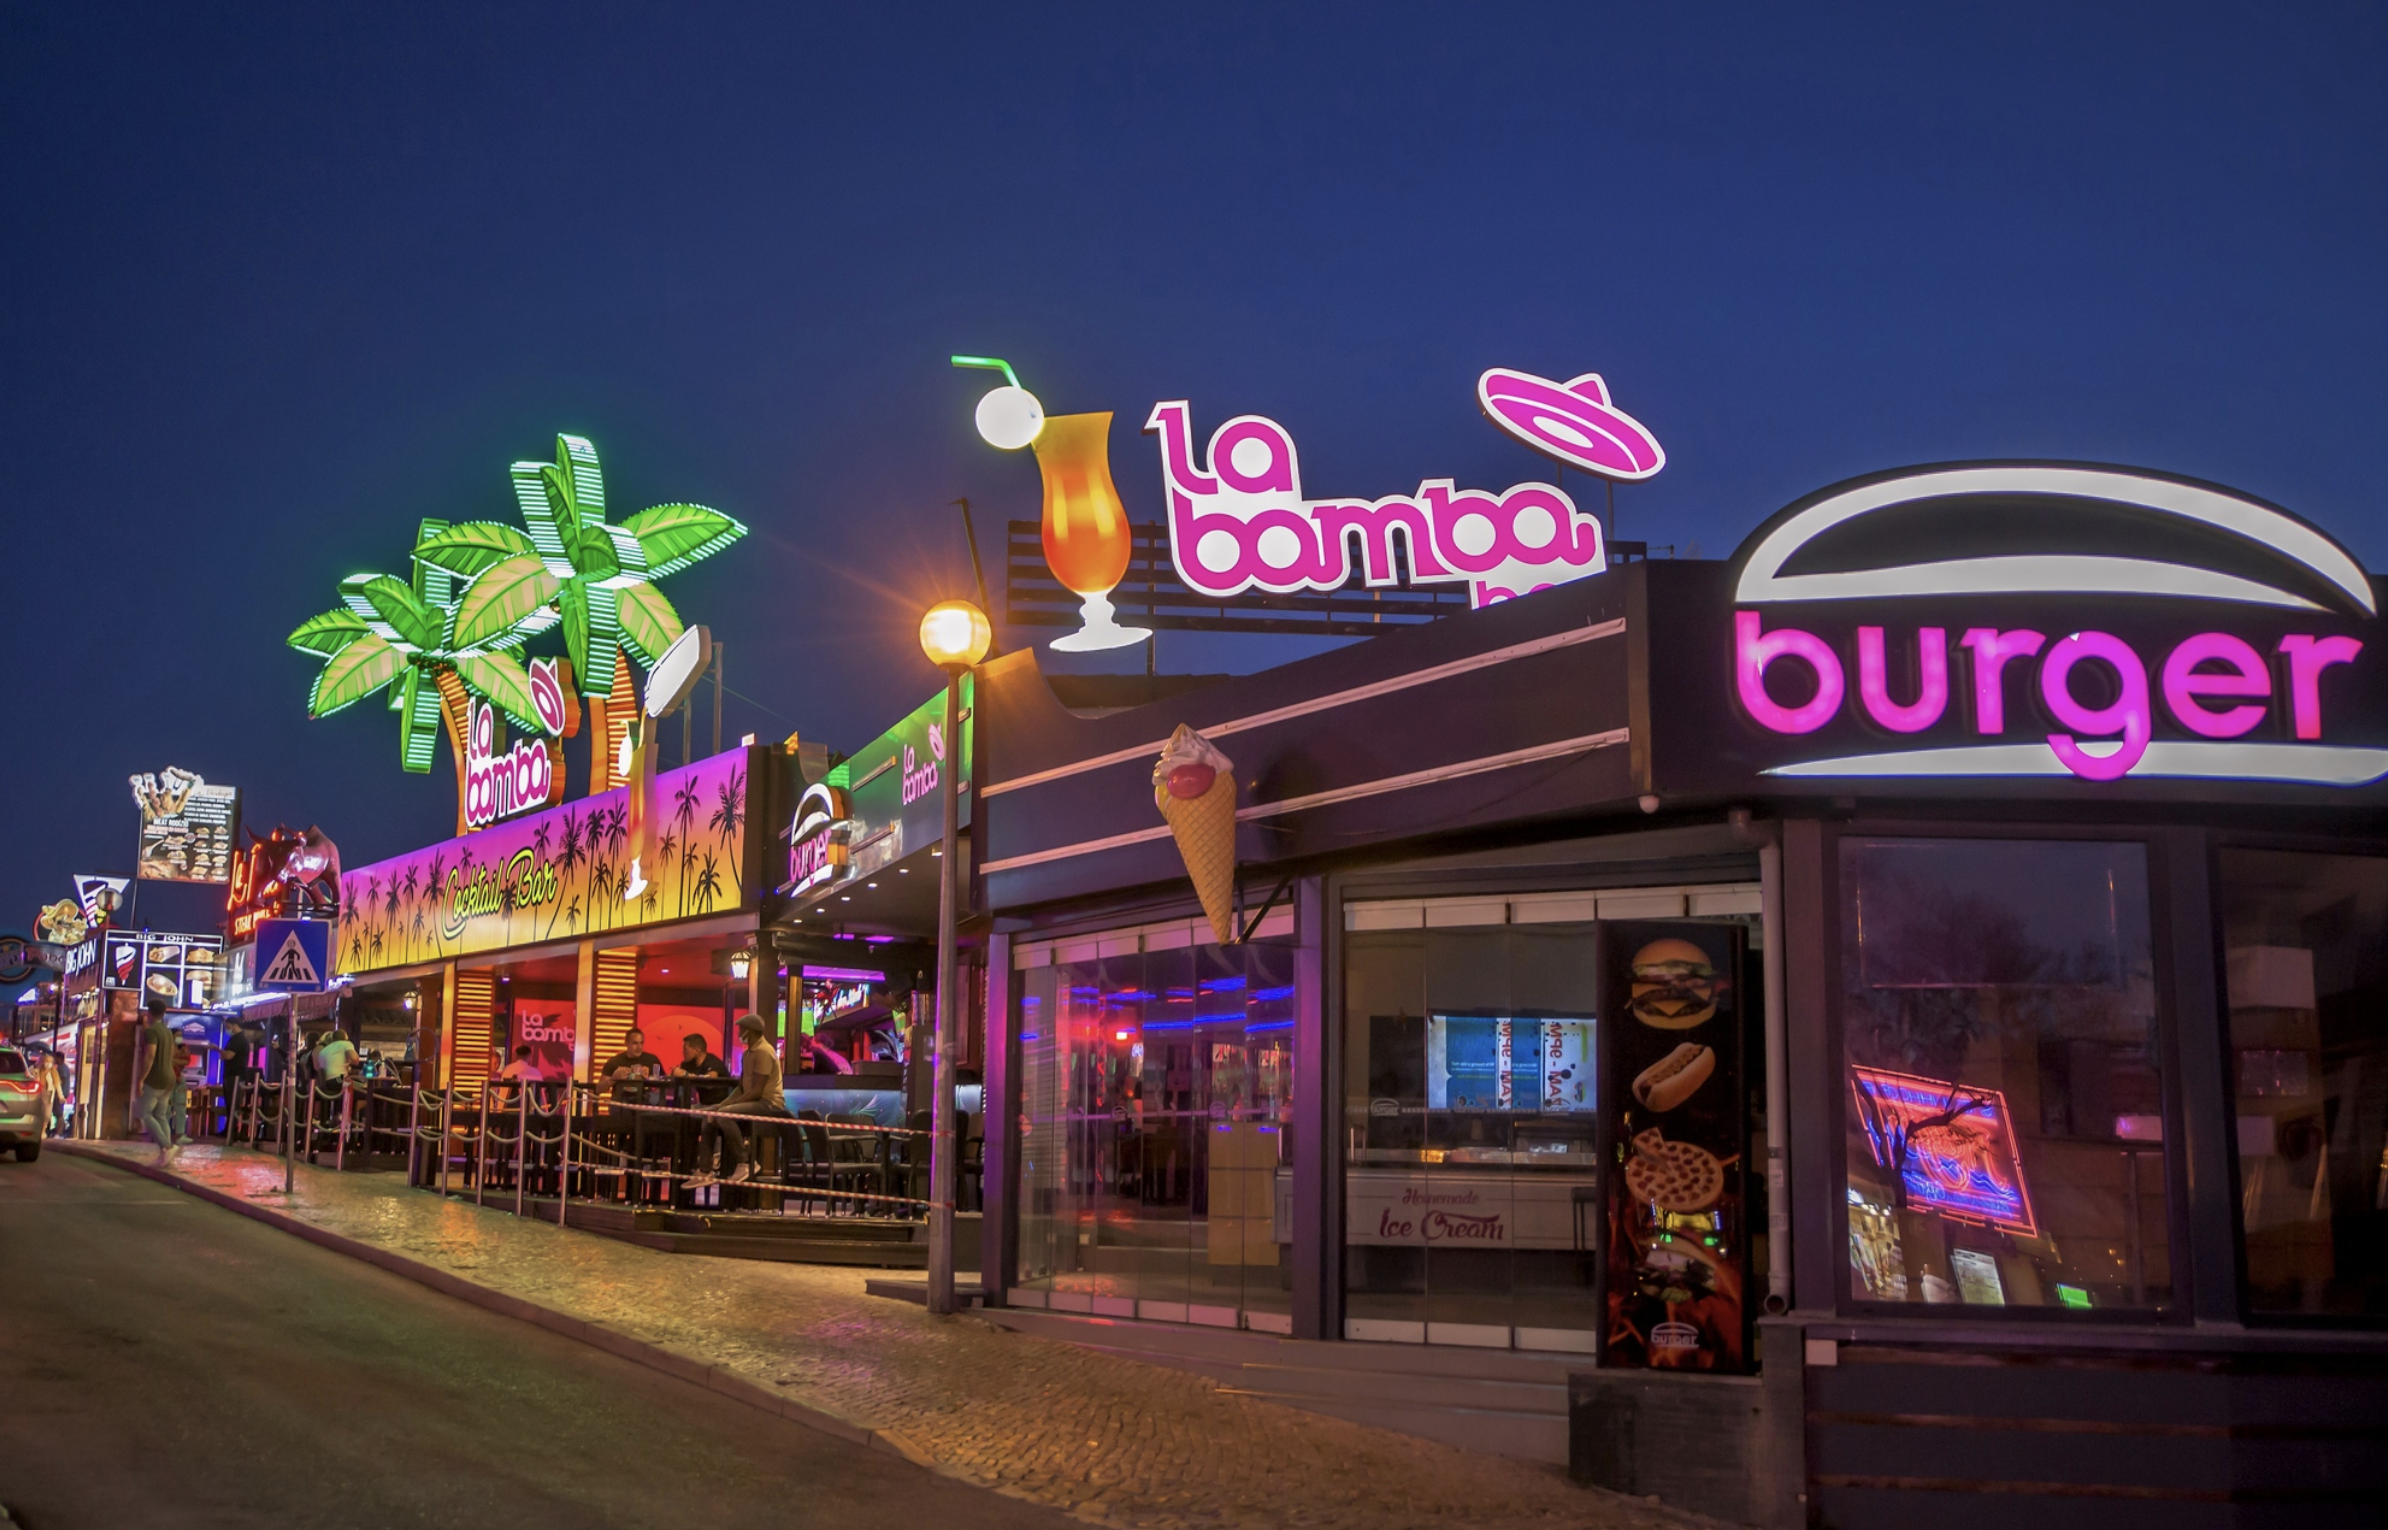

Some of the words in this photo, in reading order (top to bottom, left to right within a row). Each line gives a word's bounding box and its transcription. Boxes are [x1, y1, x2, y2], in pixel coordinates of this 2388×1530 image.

[1169, 484, 1599, 592] bamba
[1735, 611, 2363, 781] burger
[466, 743, 550, 824] bamba
[902, 760, 939, 806] bamba
[789, 828, 832, 887] burger
[441, 857, 503, 941] Cocktail
[506, 846, 558, 910] Bar
[65, 947, 78, 975] BIG
[76, 938, 97, 976] JOHN
[135, 933, 156, 941] BIG
[163, 934, 194, 942] JOHN
[521, 1023, 576, 1042] bamb
[1402, 1187, 1480, 1206] Homemade
[1379, 1207, 1413, 1238] Ice
[1421, 1209, 1504, 1241] Cream
